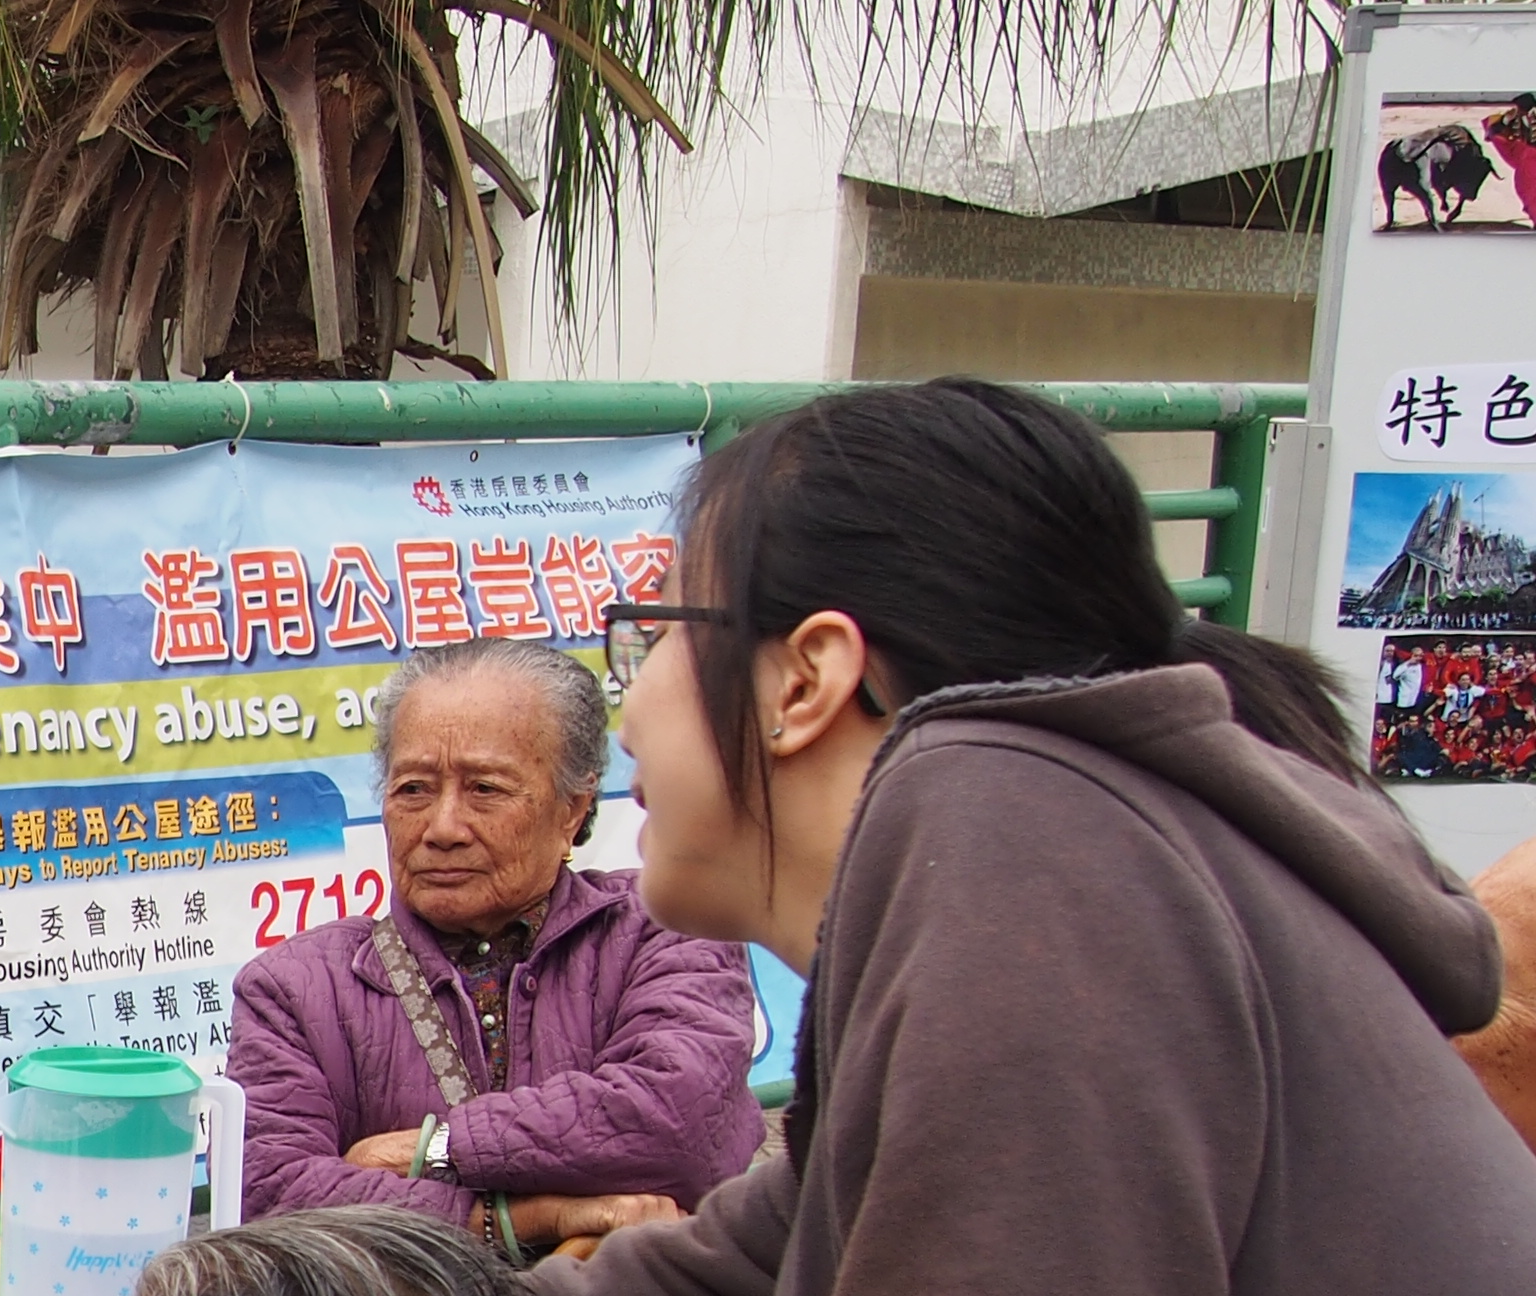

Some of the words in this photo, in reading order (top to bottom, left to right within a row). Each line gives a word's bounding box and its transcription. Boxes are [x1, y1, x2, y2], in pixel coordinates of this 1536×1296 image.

[1385, 373, 1536, 449] 特色
[449, 470, 591, 500] 香港房屋委員會
[459, 502, 506, 520] Hong
[505, 500, 546, 518] Kong
[546, 497, 607, 517] Housing
[606, 490, 676, 512] Authority
[153, 686, 318, 745] abuse,
[39, 860, 57, 881] to
[60, 853, 119, 882] Report
[122, 846, 207, 874] Tenancy
[211, 836, 289, 865] Abuses:
[71, 942, 146, 974] Authority
[153, 934, 215, 964] Hotline
